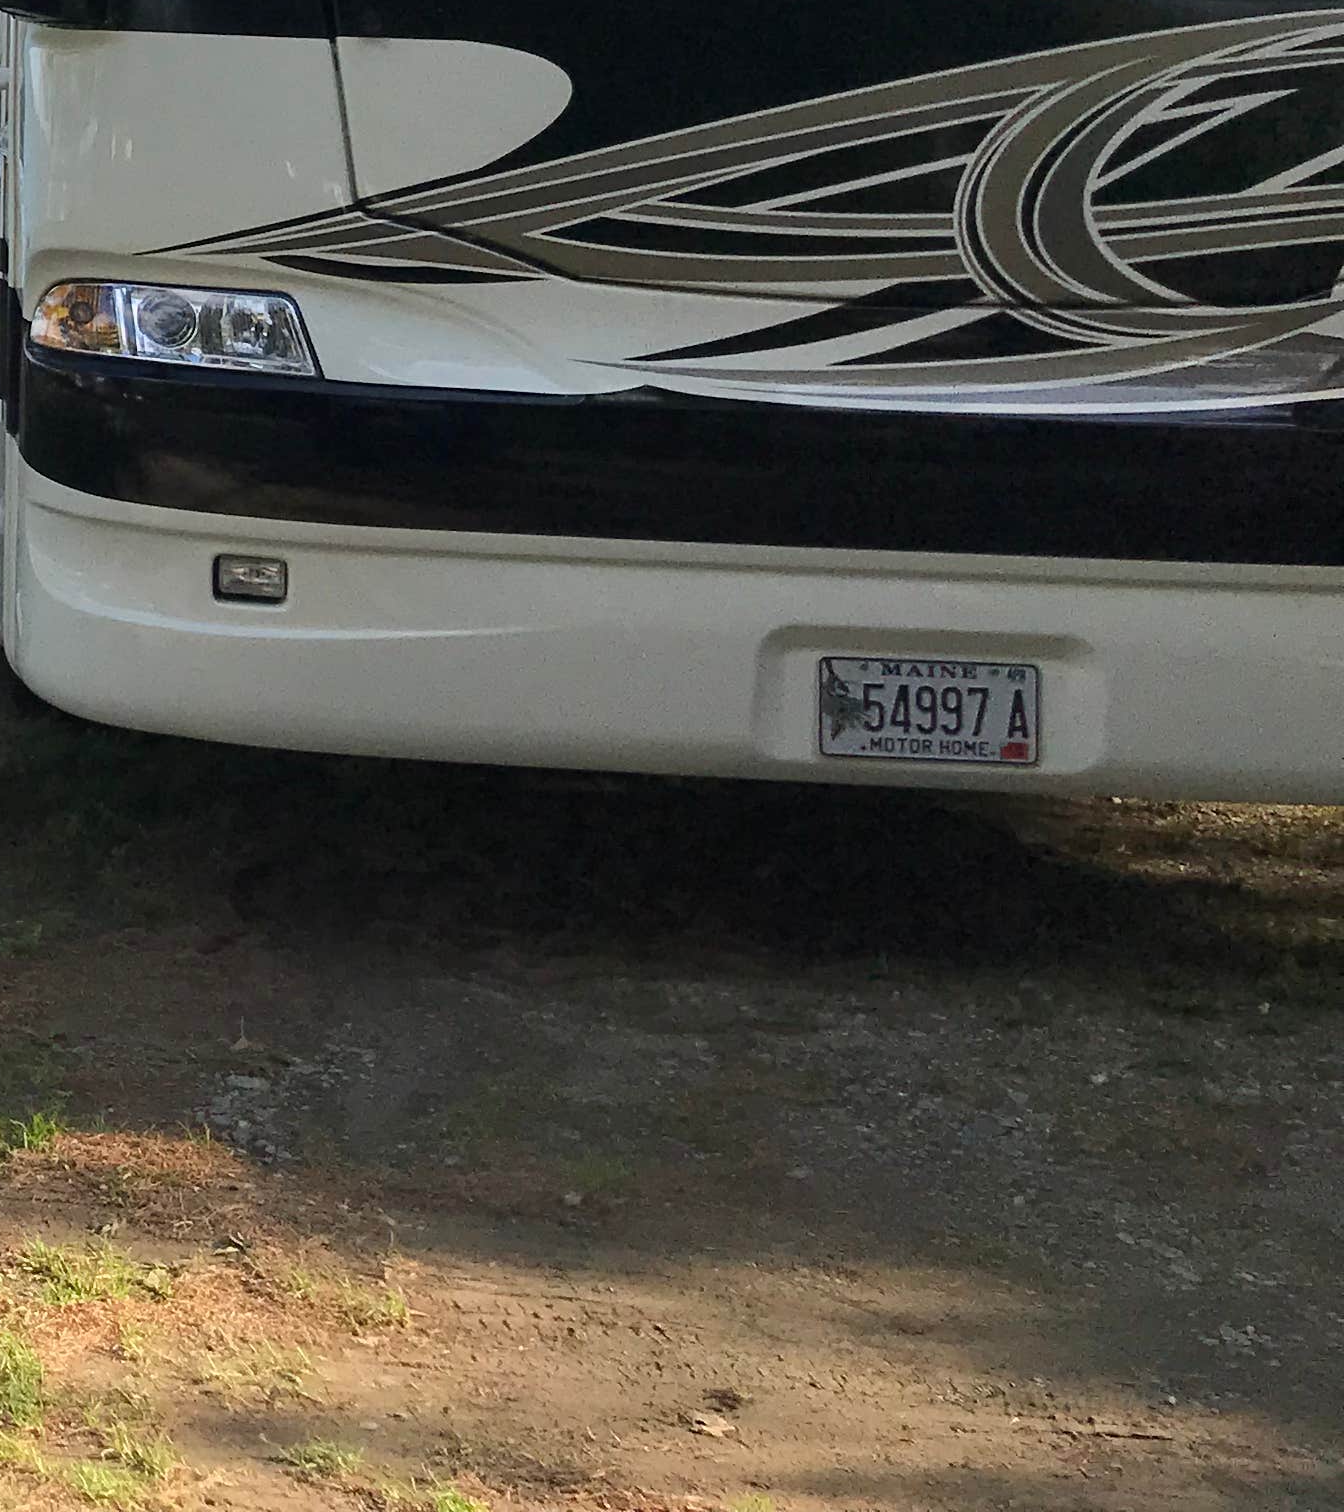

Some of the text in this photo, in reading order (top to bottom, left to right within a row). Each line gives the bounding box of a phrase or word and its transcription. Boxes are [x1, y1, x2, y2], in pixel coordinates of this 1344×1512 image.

[881, 663, 978, 679] MAINE
[862, 683, 1028, 738] 54997 A
[869, 738, 990, 758] MOTOR HOME
